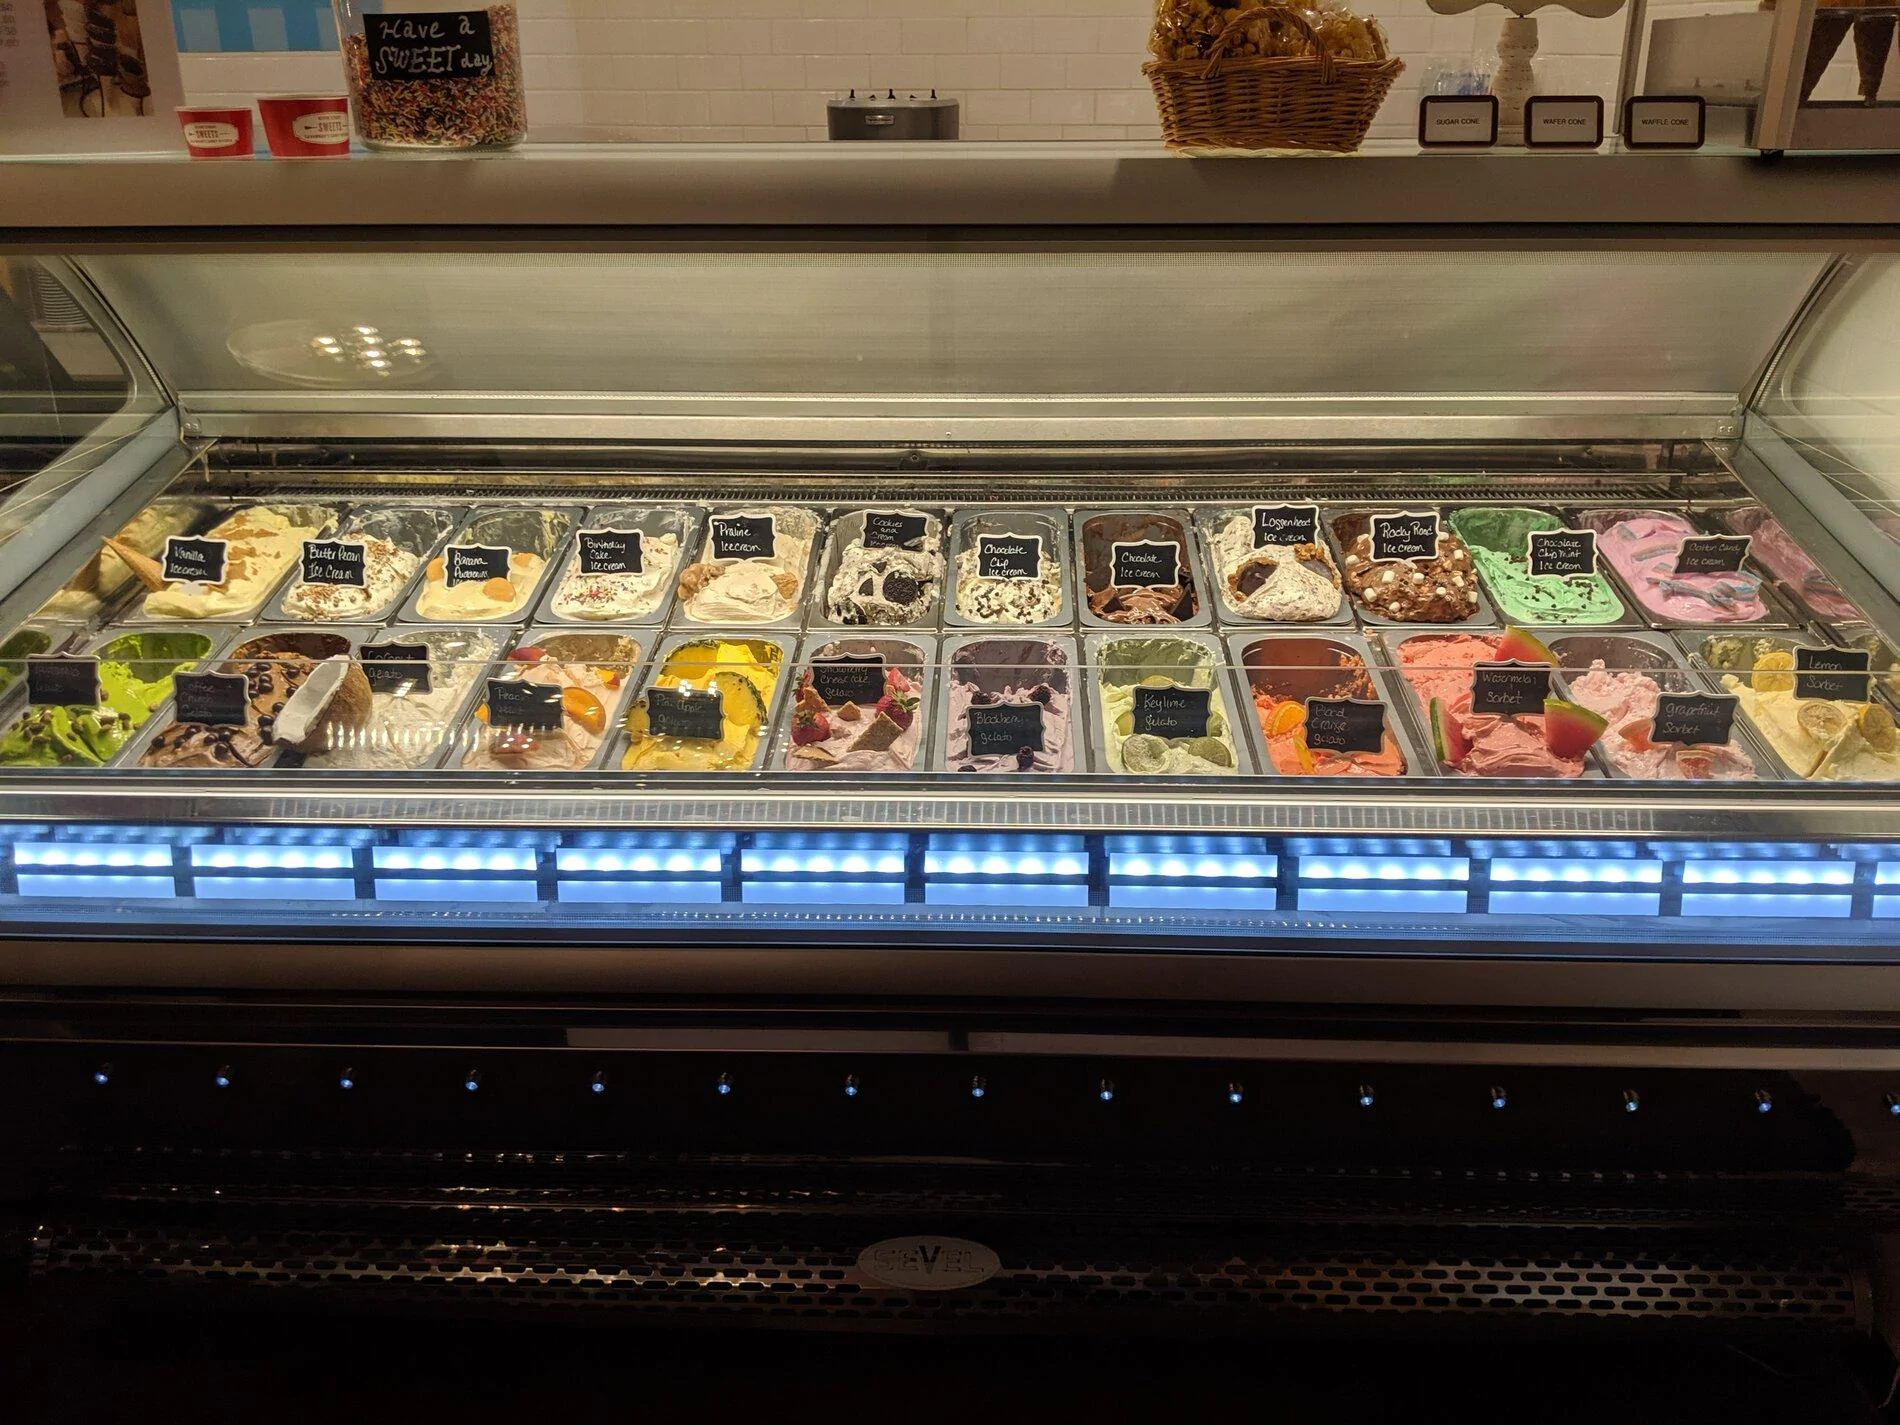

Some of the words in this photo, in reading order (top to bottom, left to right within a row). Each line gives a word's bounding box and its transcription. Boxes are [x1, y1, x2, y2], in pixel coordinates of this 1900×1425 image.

[379, 19, 446, 39] Have
[459, 15, 476, 34] a
[376, 44, 461, 74] SWEET
[460, 51, 494, 77] day
[1435, 118, 1460, 127] SUGAR
[1461, 117, 1481, 126] CONE
[1542, 118, 1567, 127] WAFER
[1568, 118, 1587, 127] CONE
[1641, 118, 1669, 127] WAFFLE
[1670, 118, 1689, 127] CONE
[719, 521, 753, 537] Praline
[872, 517, 903, 529] Cookies
[880, 527, 899, 535] and
[1380, 522, 1411, 542] Rocky
[1410, 521, 1434, 537] Road
[584, 537, 627, 554] Birthday
[983, 543, 1028, 555] Chocolate
[1537, 538, 1582, 549] Chocolate
[174, 545, 206, 562] Vanilla
[590, 549, 612, 560] Cake
[1121, 552, 1163, 563] Chocolate
[308, 561, 324, 579] Ice
[325, 564, 355, 580] Cream
[989, 557, 1009, 570] Chip
[1809, 655, 1843, 671] Lemon
[1482, 670, 1537, 685] Watermelon
[1487, 689, 1524, 704] Sorbet
[1663, 721, 1700, 736] Sorbet
